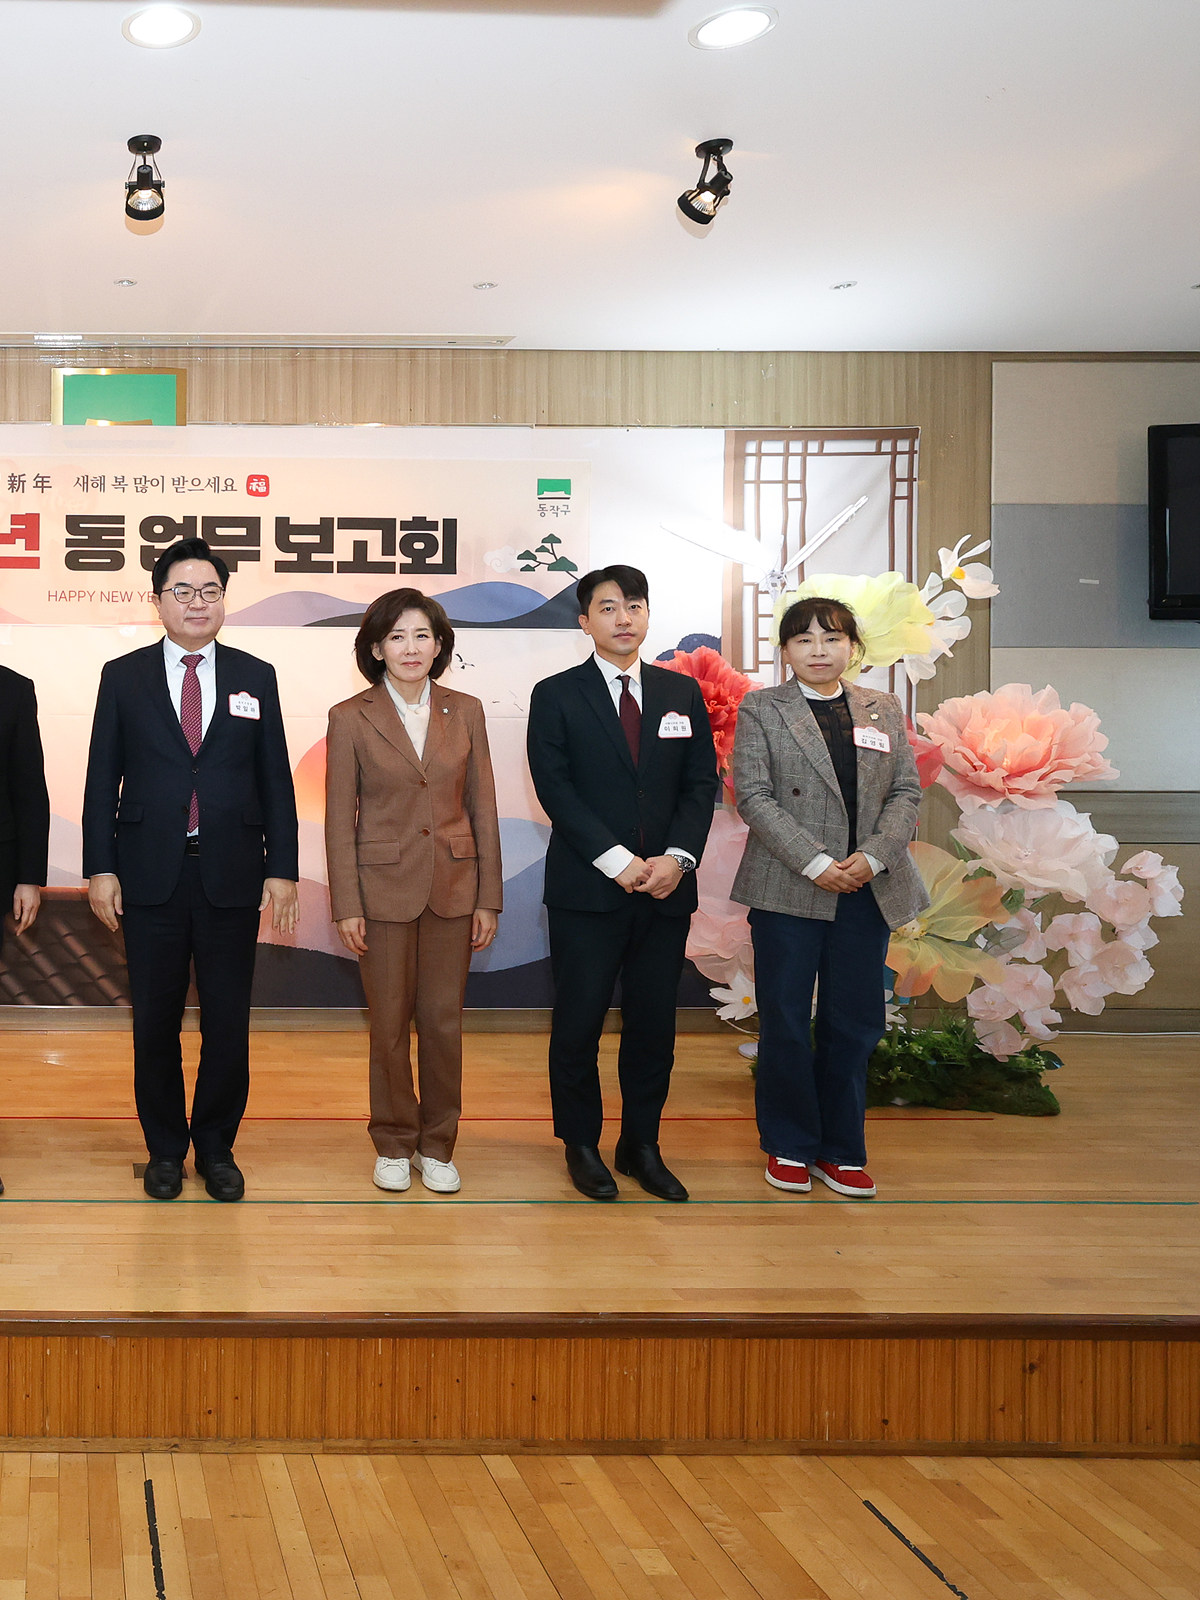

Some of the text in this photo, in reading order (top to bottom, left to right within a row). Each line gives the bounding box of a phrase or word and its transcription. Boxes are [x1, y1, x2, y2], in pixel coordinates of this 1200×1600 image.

[73, 474, 238, 493] 새해 복 많이 받으세요
[537, 503, 571, 518] 동작구
[64, 514, 126, 572] 동
[274, 516, 458, 575] 보고회
[47, 590, 96, 603] HAPPY
[100, 590, 134, 603] NEW
